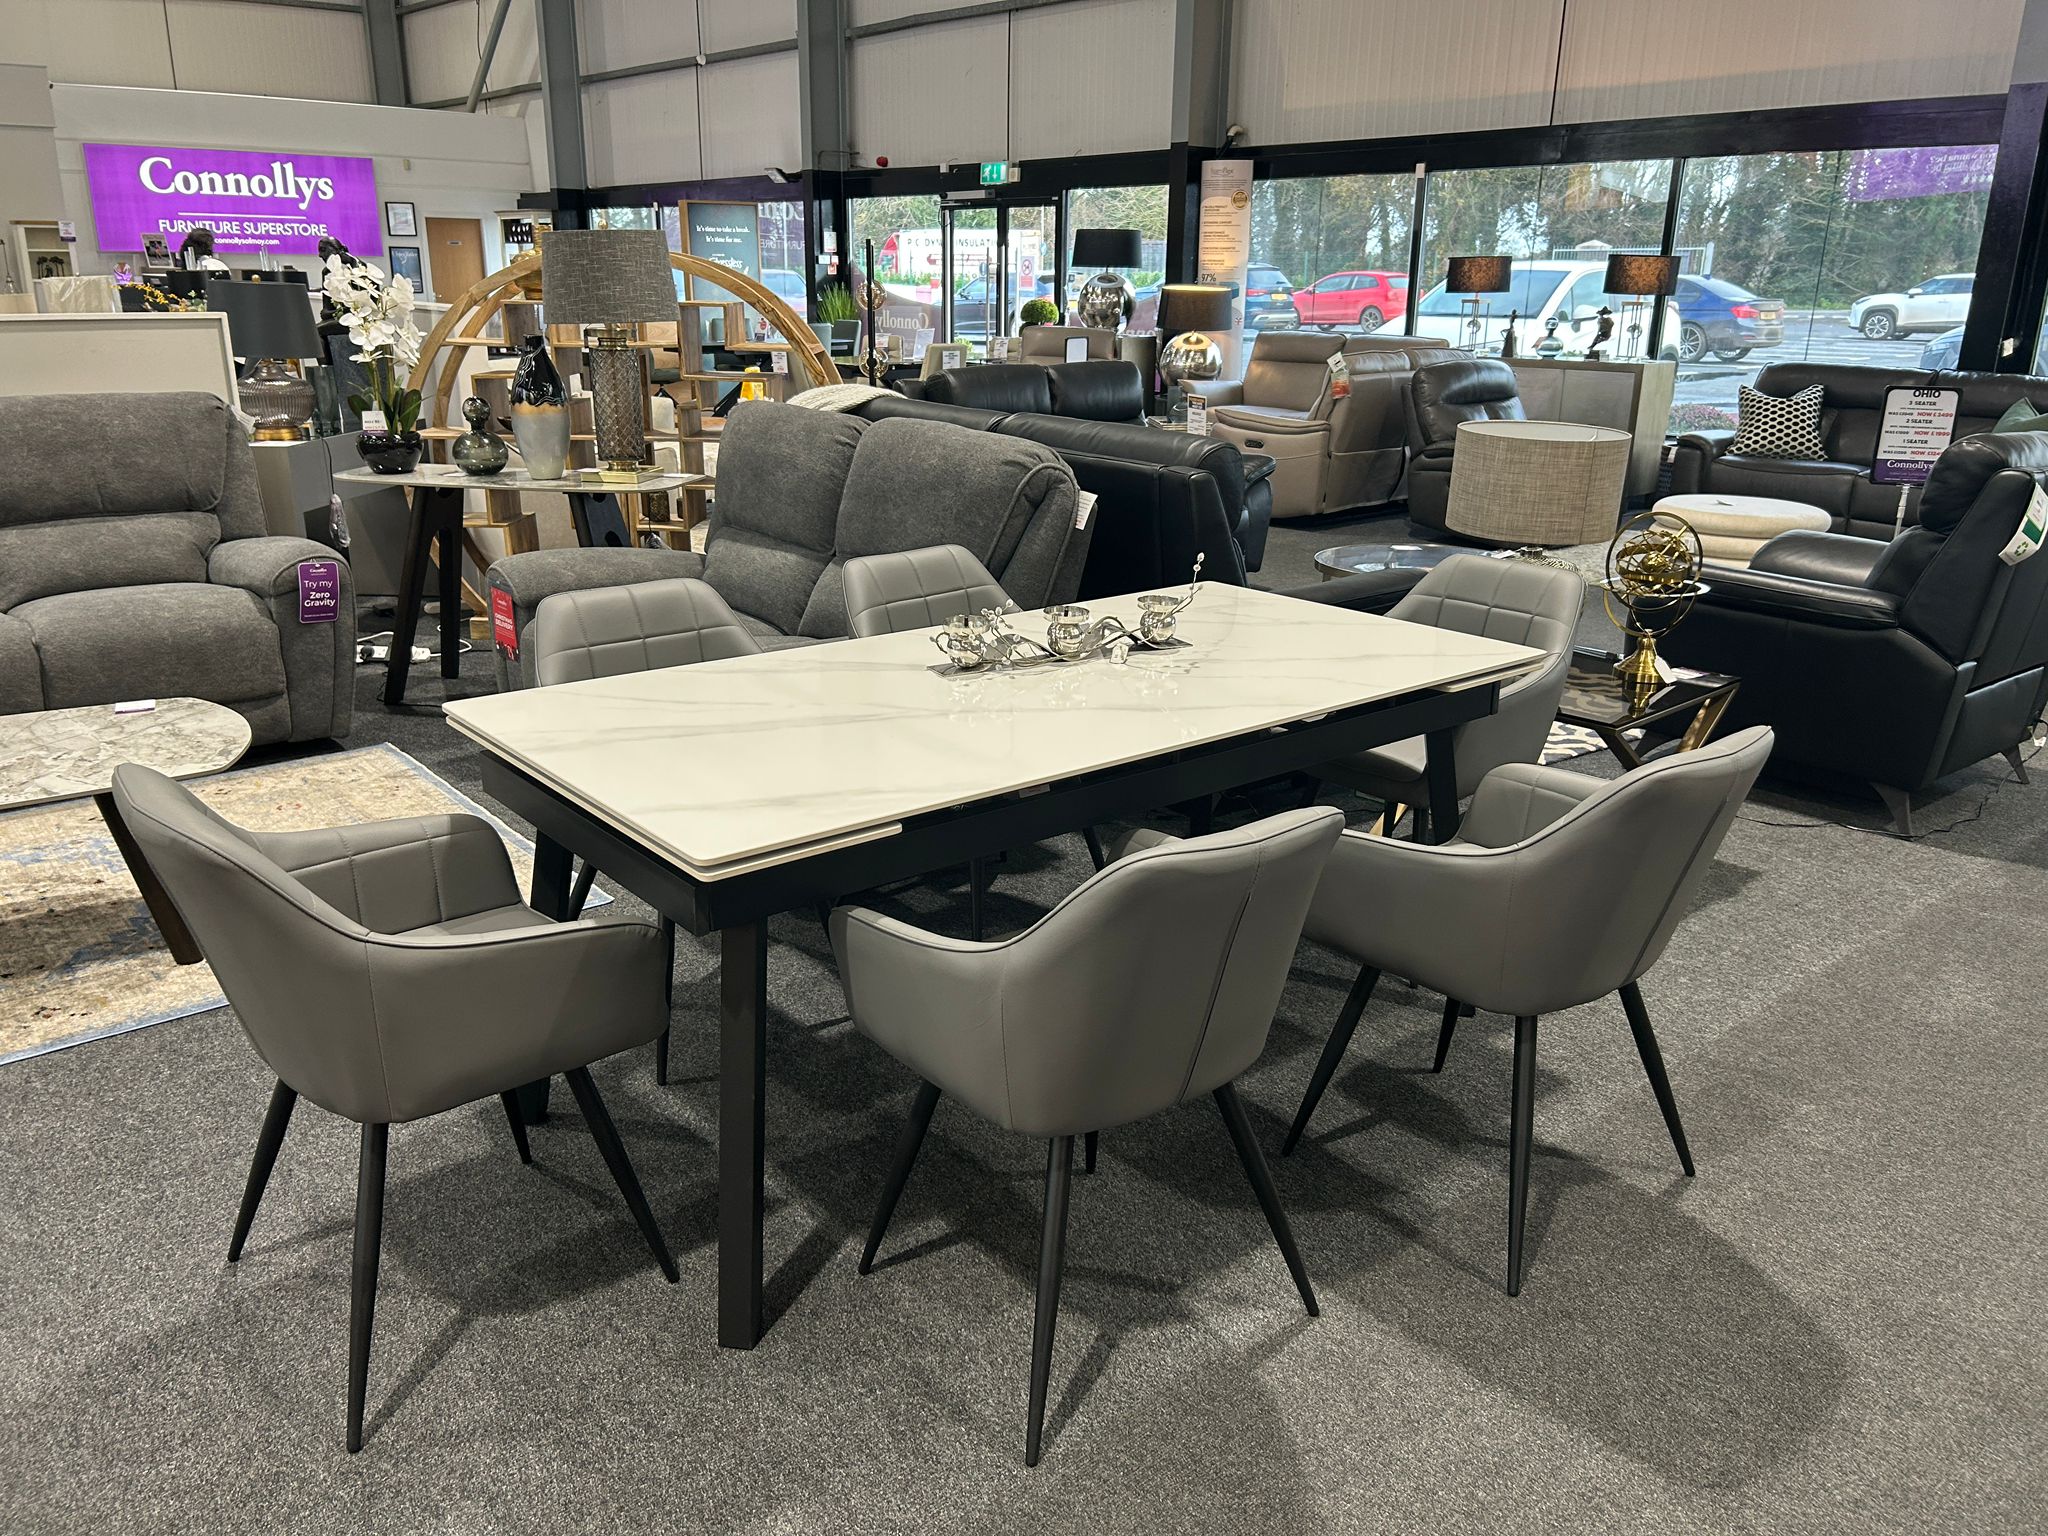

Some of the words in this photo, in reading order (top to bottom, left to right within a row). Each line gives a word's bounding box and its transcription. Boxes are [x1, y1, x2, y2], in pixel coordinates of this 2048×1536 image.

[139, 157, 334, 210] Connollys
[158, 219, 240, 235] FURNITURE
[243, 222, 328, 237] SUPERSTORE
[924, 238, 943, 247] DYN
[1201, 272, 1217, 283] 97%
[1913, 388, 1941, 398] OHIO
[1887, 460, 1933, 471] Connollys
[304, 580, 317, 589] Try
[304, 598, 335, 607] Gravity
